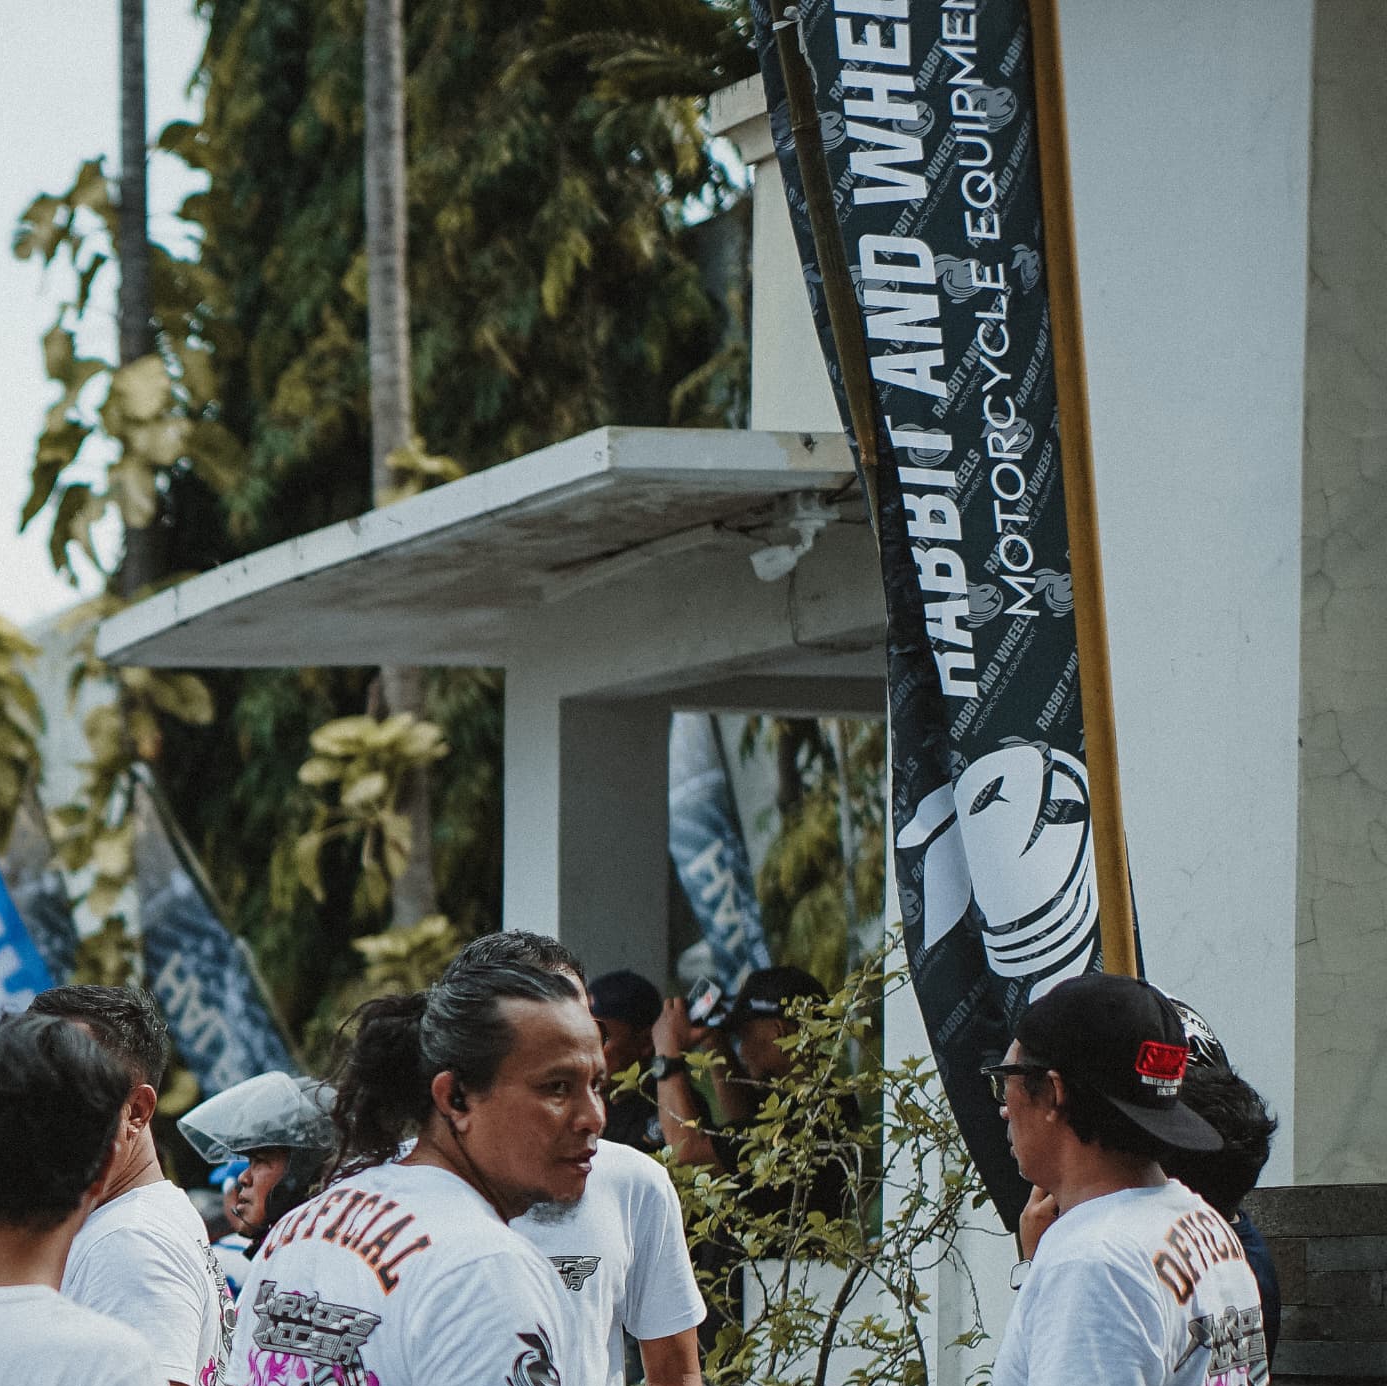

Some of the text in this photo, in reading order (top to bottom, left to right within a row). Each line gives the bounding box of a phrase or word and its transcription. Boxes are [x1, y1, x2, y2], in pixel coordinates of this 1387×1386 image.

[858, 234, 950, 398] AND
[968, 263, 1040, 617] MOTORCYCLE
[1035, 679, 1067, 732] RABBIT
